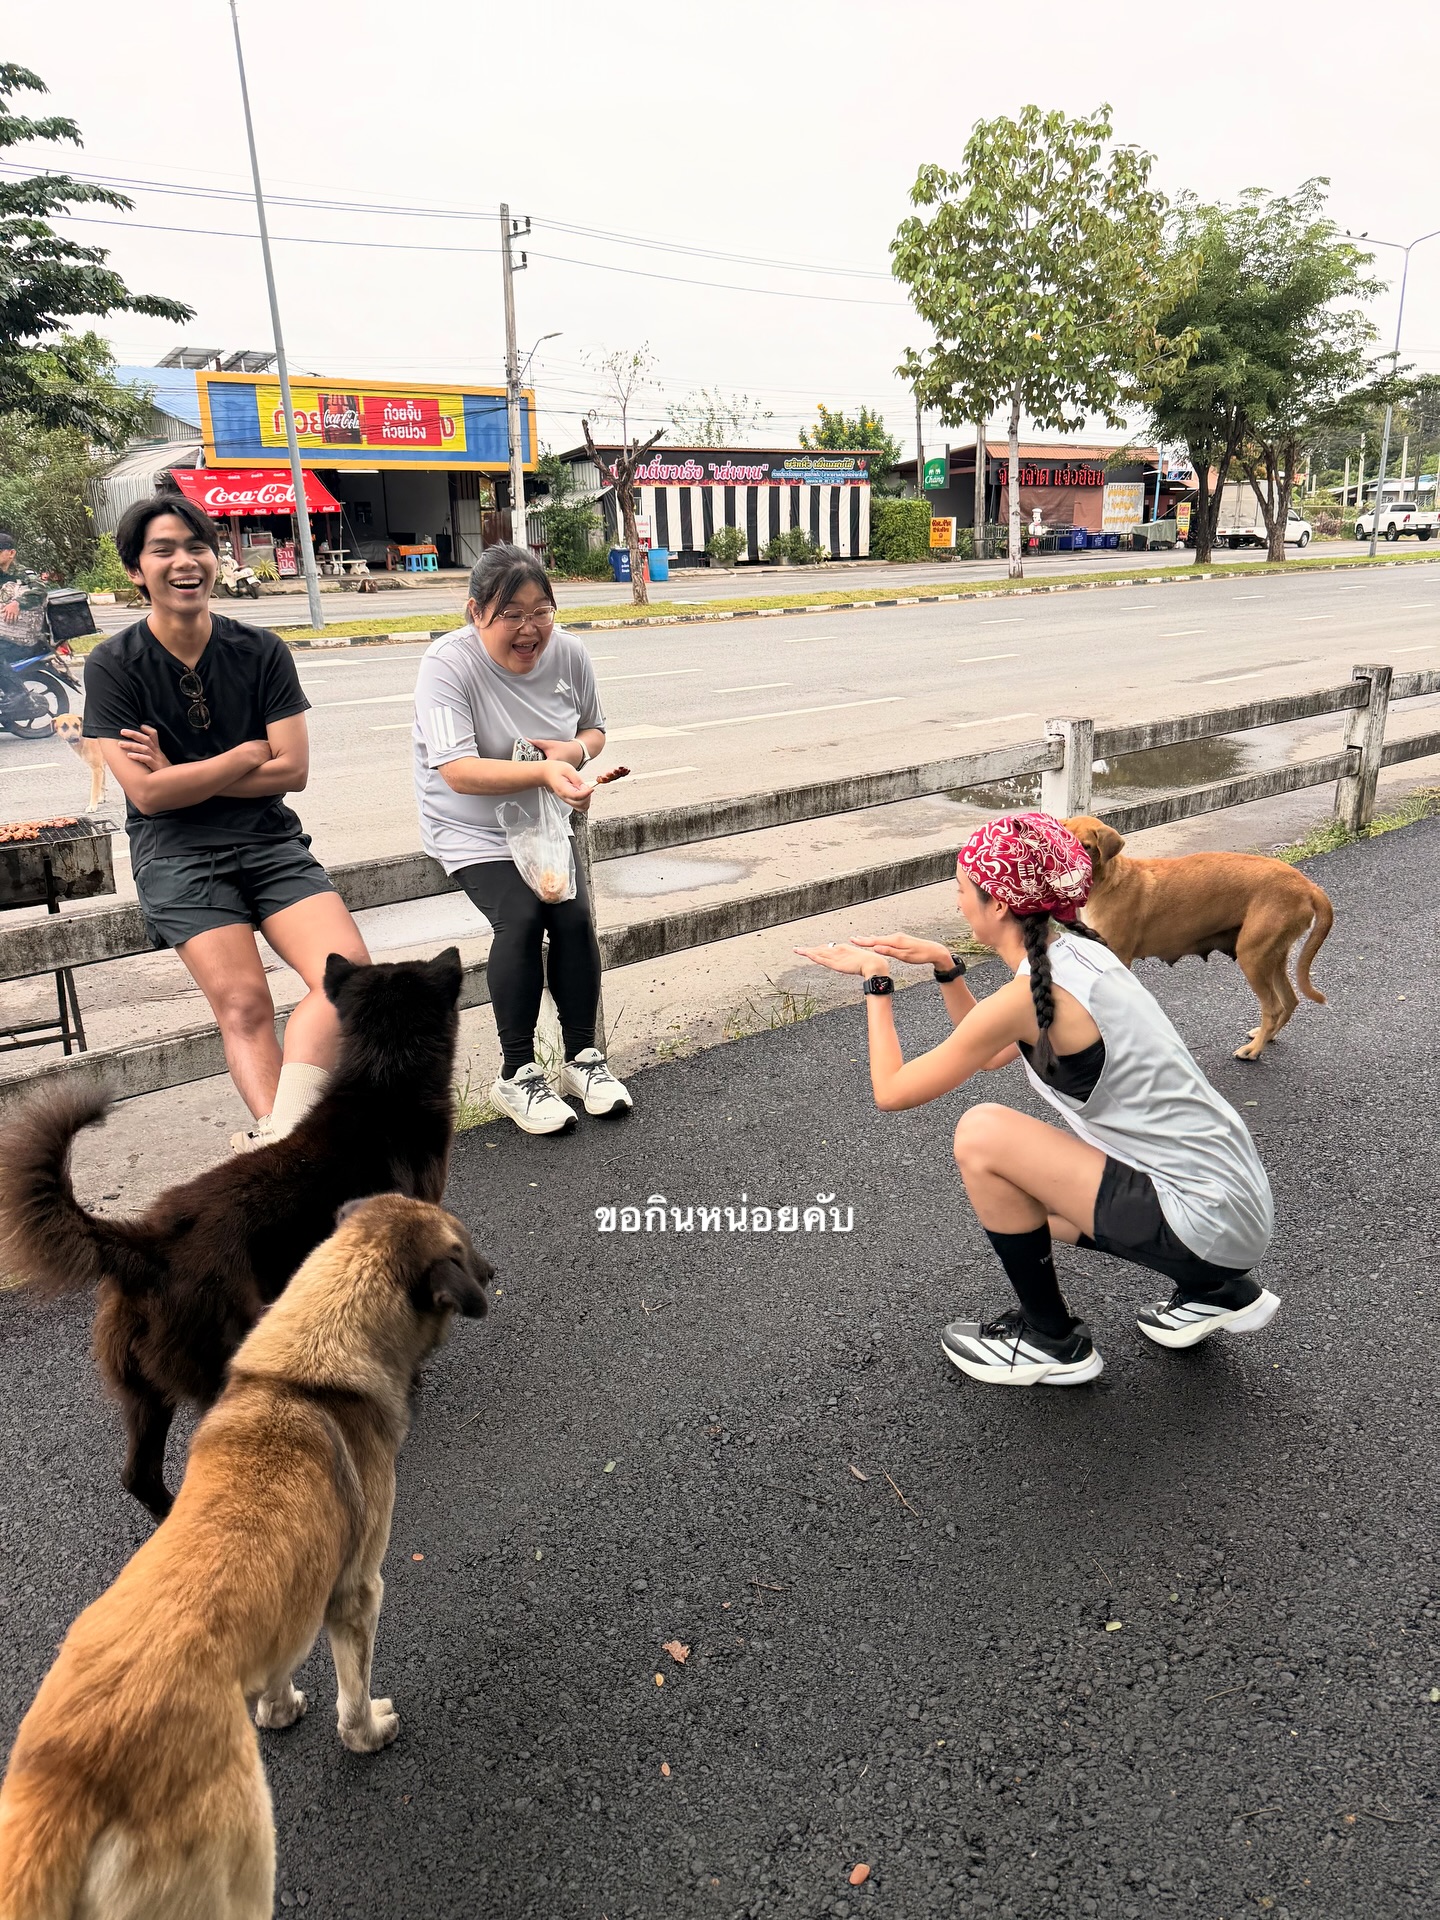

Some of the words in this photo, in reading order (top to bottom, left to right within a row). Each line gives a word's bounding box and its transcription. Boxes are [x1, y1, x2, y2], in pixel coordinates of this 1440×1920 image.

[382, 421, 426, 439] ห้วยม่วง
[925, 475, 945, 485] Chang
[205, 483, 309, 506] Coca-Col
[278, 548, 294, 559] ร้าน
